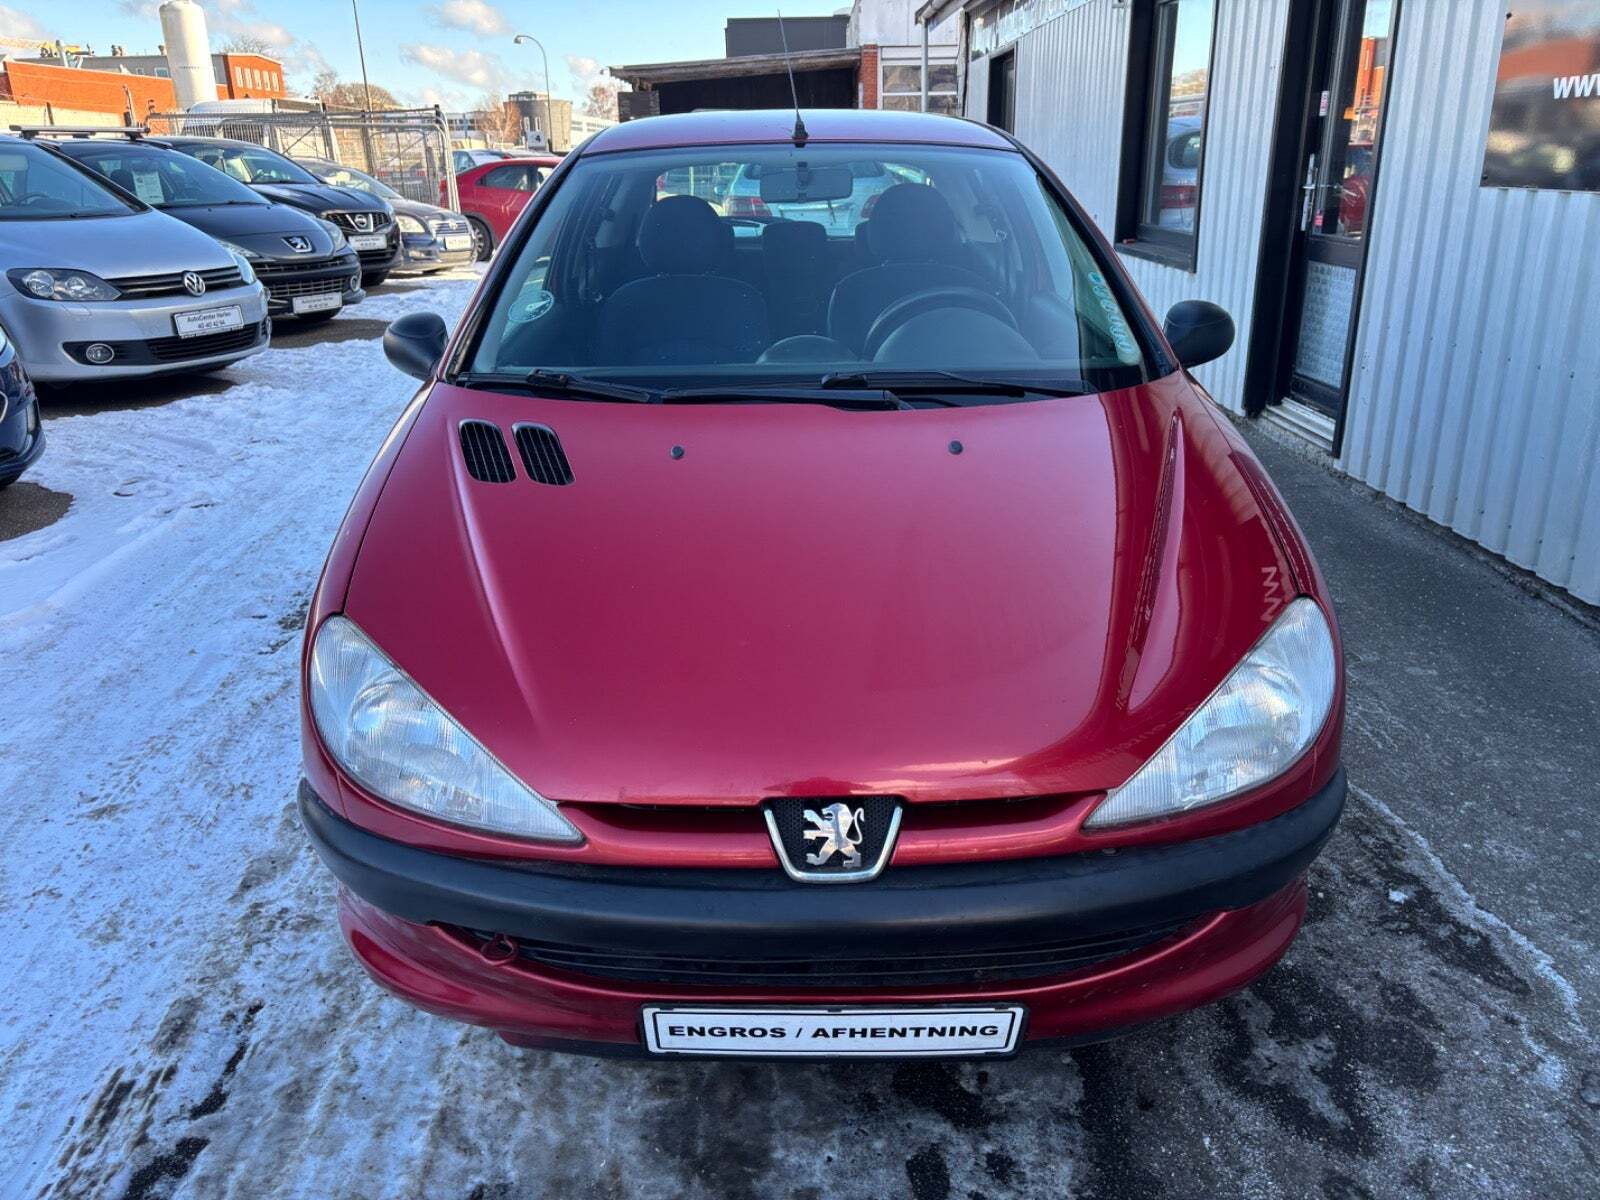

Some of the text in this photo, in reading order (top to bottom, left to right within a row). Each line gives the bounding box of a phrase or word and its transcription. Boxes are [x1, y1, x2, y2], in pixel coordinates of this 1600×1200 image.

[668, 1025, 999, 1039] ENGROS / AFHENTNING
